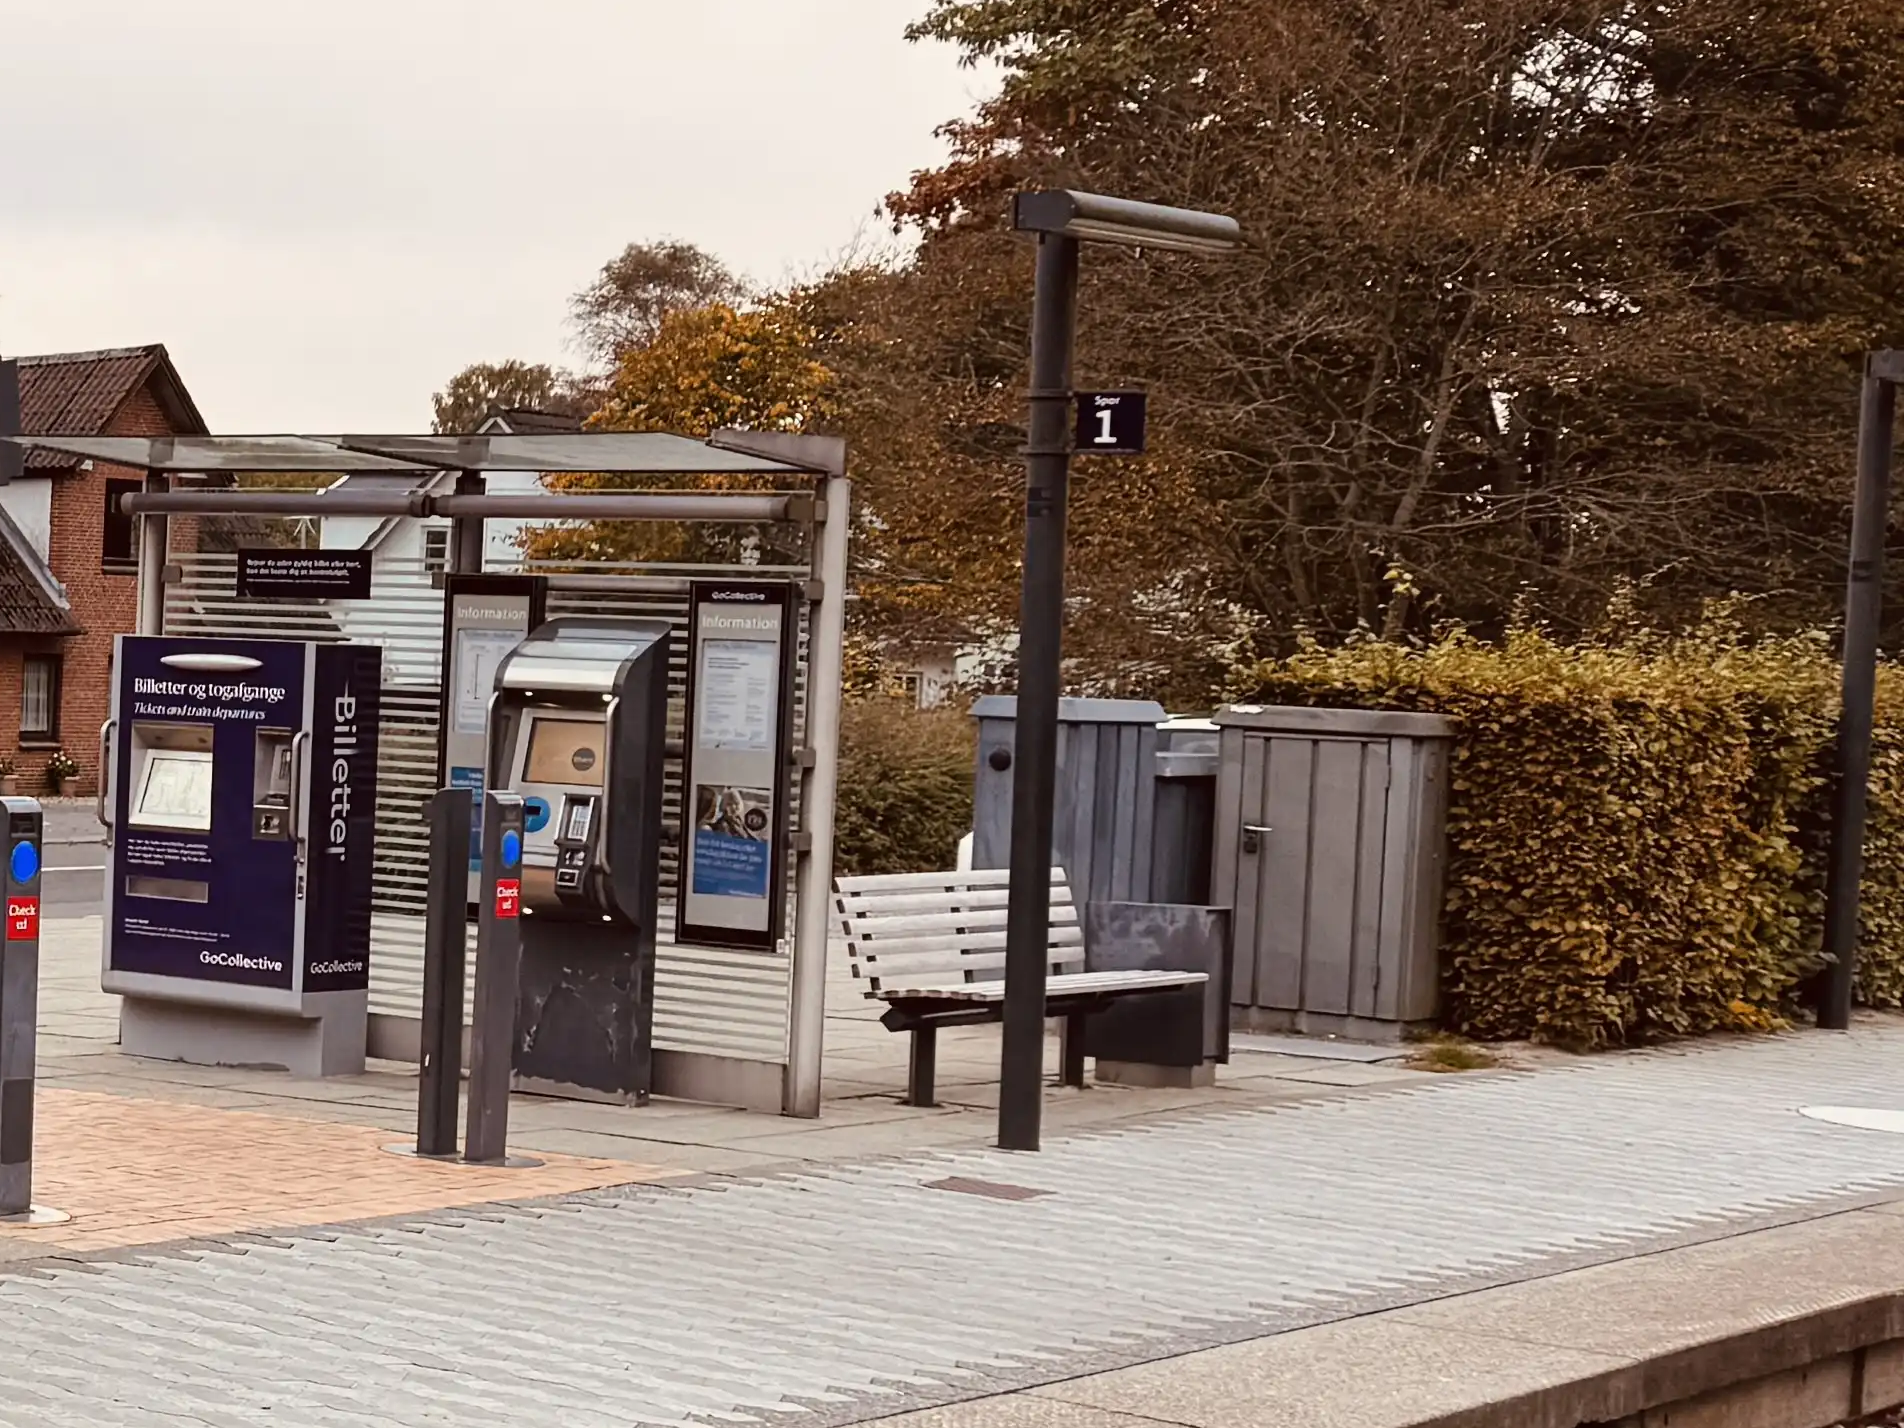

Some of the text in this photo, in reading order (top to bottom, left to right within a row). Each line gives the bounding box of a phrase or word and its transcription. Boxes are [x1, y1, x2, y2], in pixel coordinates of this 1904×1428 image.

[1094, 395, 1121, 407] Spor
[1093, 409, 1117, 443] 1
[456, 605, 527, 621] Information
[702, 614, 778, 630] Information
[134, 676, 286, 704] Billetter og togafgange
[134, 701, 267, 721] Tickets and train departures
[325, 695, 358, 863] Billetter
[8, 903, 37, 917] Check
[199, 950, 283, 972] GoCollective
[310, 959, 364, 974] GoCollective
